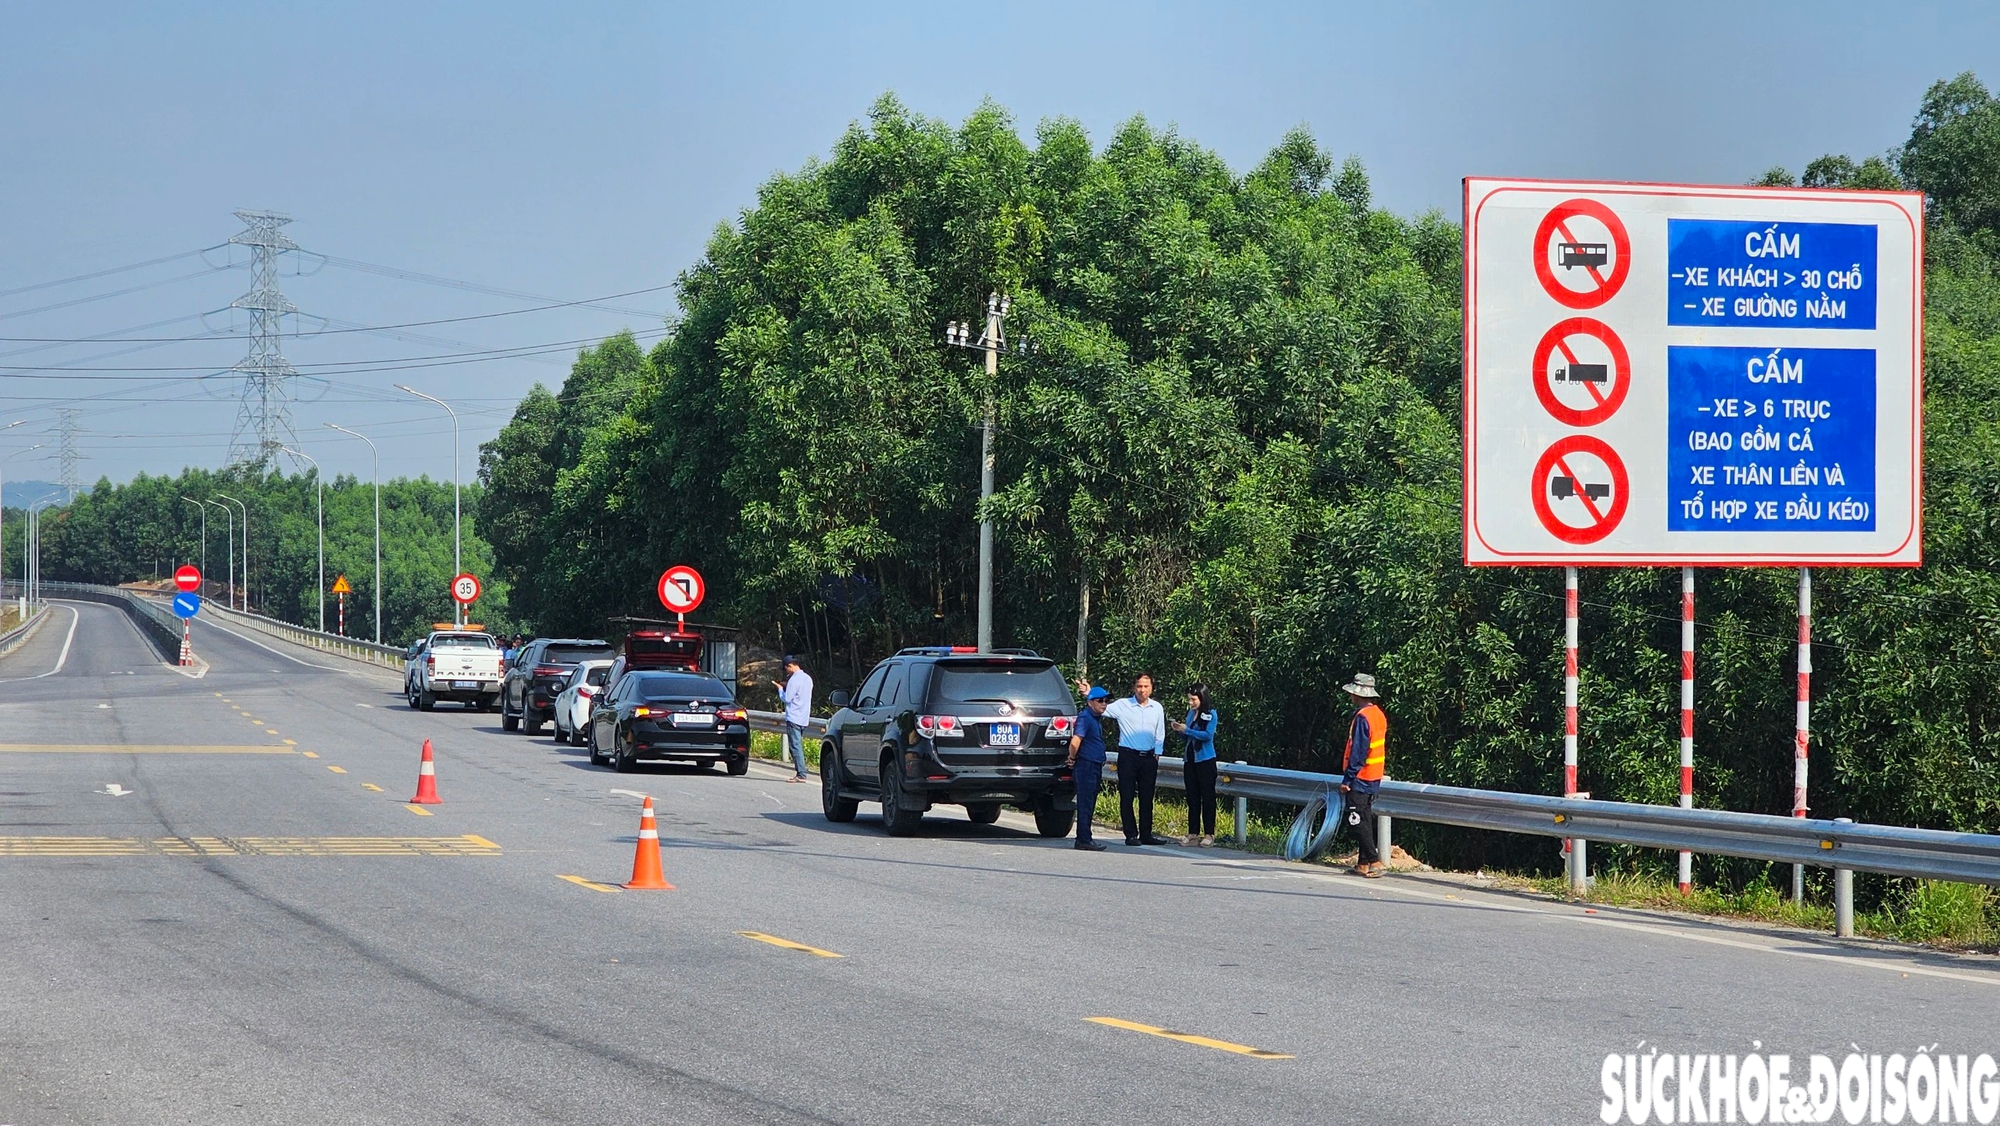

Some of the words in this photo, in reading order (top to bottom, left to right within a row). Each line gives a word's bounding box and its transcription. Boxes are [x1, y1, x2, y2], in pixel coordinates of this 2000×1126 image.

[1745, 224, 1800, 258] CẤM
[1718, 264, 1778, 288] KHÁCH
[1783, 272, 1796, 286] >
[1801, 270, 1821, 289] 30
[1827, 263, 1862, 290] CHỖ
[1702, 297, 1725, 317] XE
[1734, 293, 1797, 318] GIƯỜNG
[1806, 292, 1846, 319] NẰM
[1747, 348, 1803, 384] CẤM
[1763, 399, 1774, 418] 6
[1782, 400, 1831, 423] TRỤC
[1688, 430, 1732, 452] (BAO
[1741, 425, 1780, 452] GỒM
[1788, 427, 1814, 451] CẢ
[1690, 466, 1715, 485] XE
[1723, 463, 1773, 485] THÂN
[1780, 459, 1818, 486] LIỀN
[1824, 463, 1845, 486] VÀ
[1681, 491, 1704, 520] TỔ
[1712, 501, 1748, 523] HỢP
[1755, 502, 1778, 520] XE
[1785, 493, 1821, 520] ĐẦU
[1828, 497, 1870, 522] KÉO)
[460, 582, 472, 594] 35
[997, 724, 1013, 734] 80A
